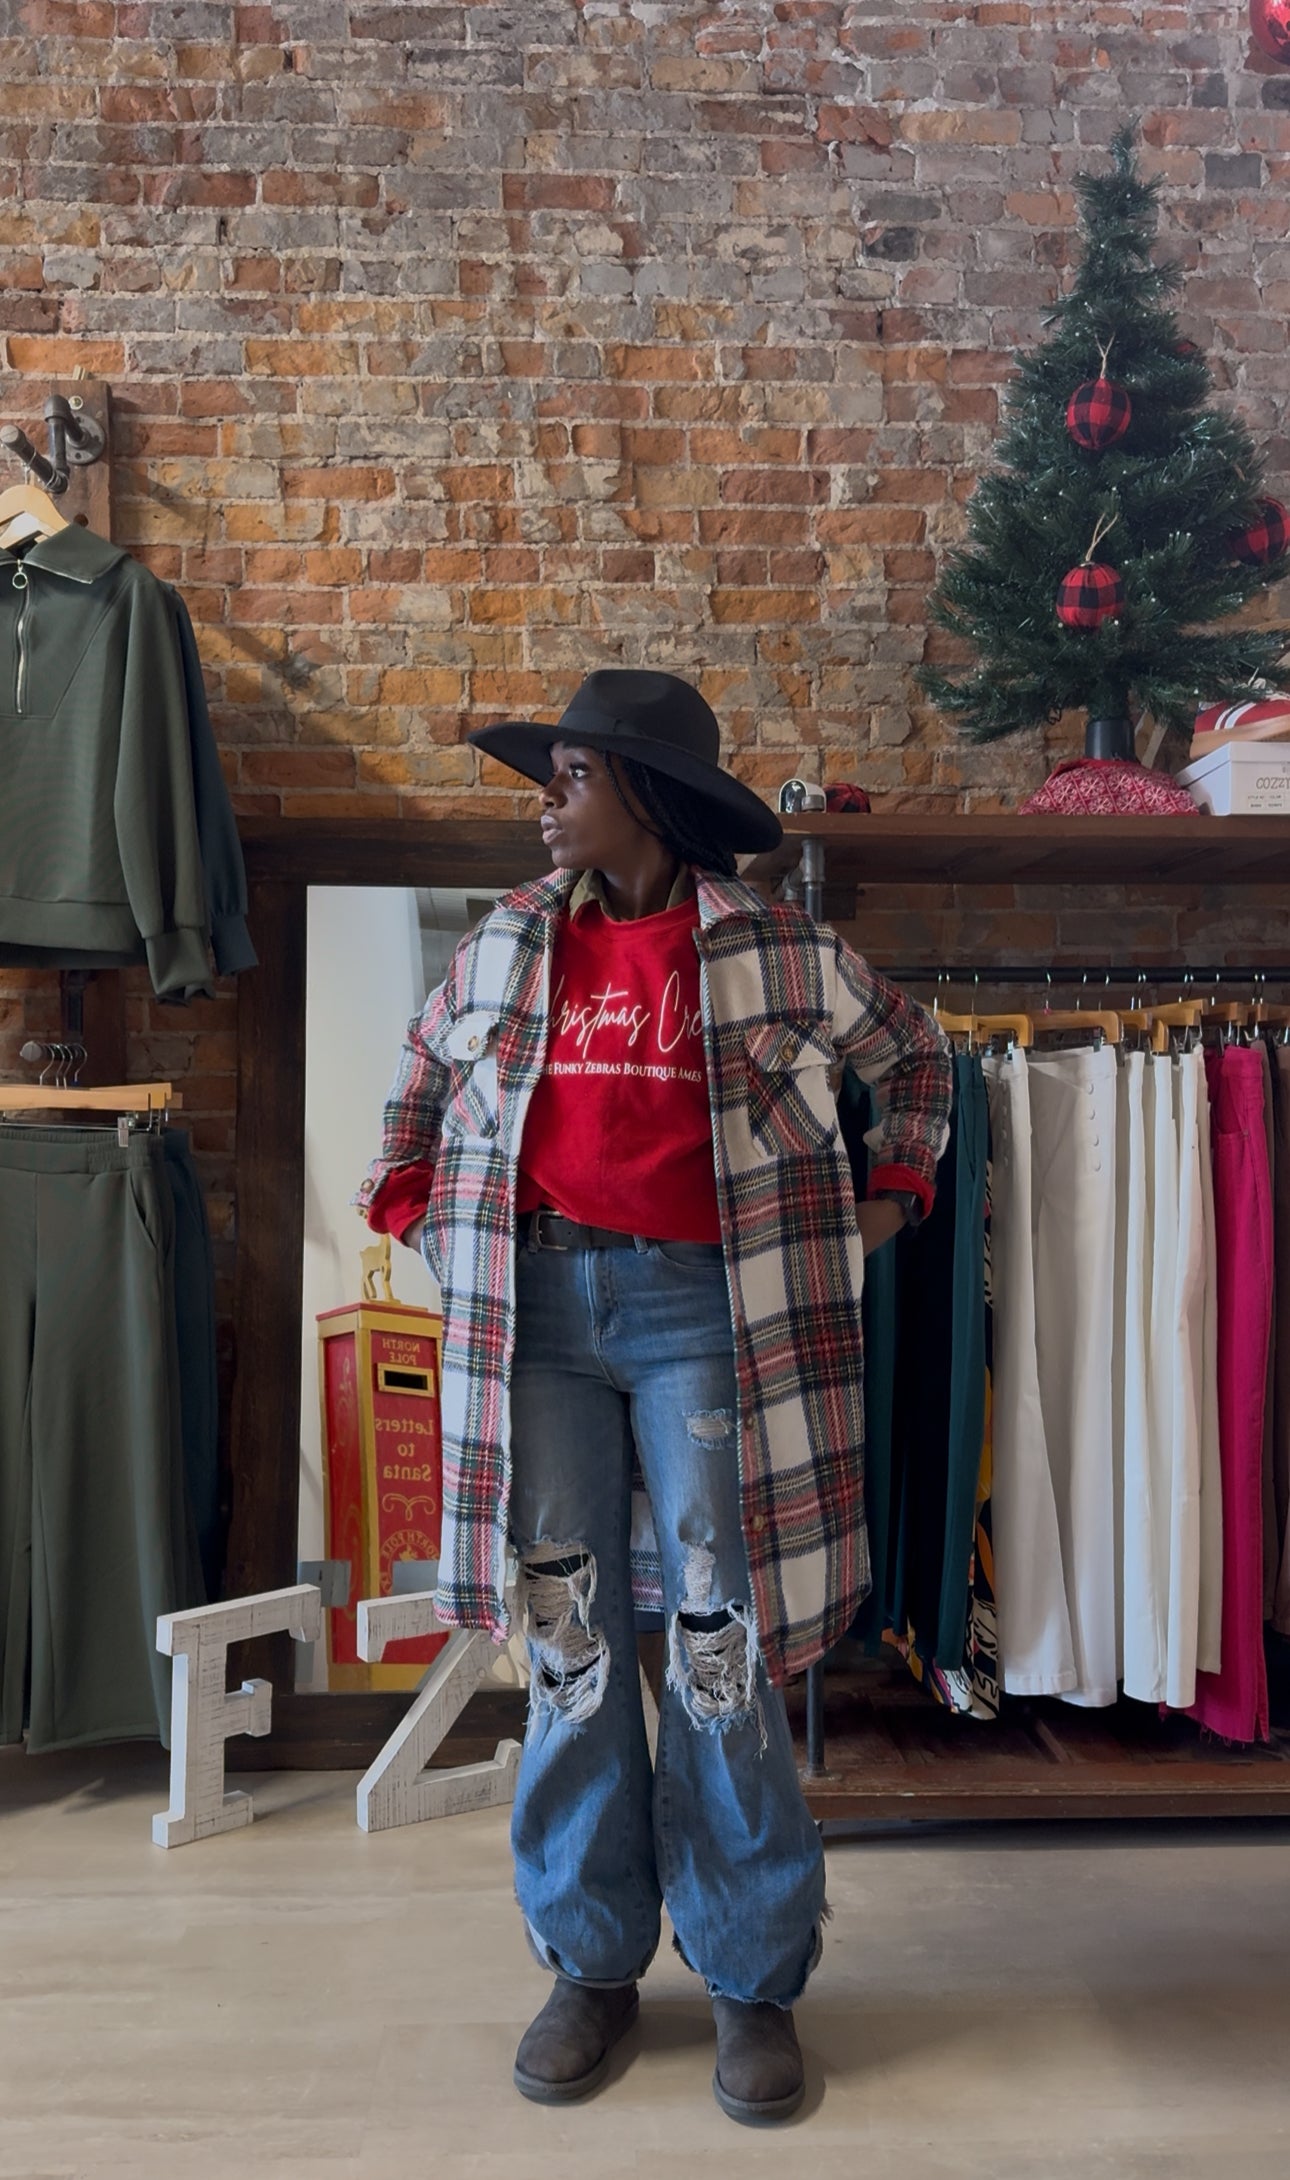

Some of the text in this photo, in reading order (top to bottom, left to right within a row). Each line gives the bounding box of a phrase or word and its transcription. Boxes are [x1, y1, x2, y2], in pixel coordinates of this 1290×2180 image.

[549, 970, 703, 1060] hristmas Cre
[554, 1061, 584, 1075] FUNKY
[585, 1061, 622, 1075] ZEBRAS
[623, 1062, 678, 1082] BOUTIQUE
[678, 1067, 703, 1083] AMES
[152, 1583, 321, 1849] F
